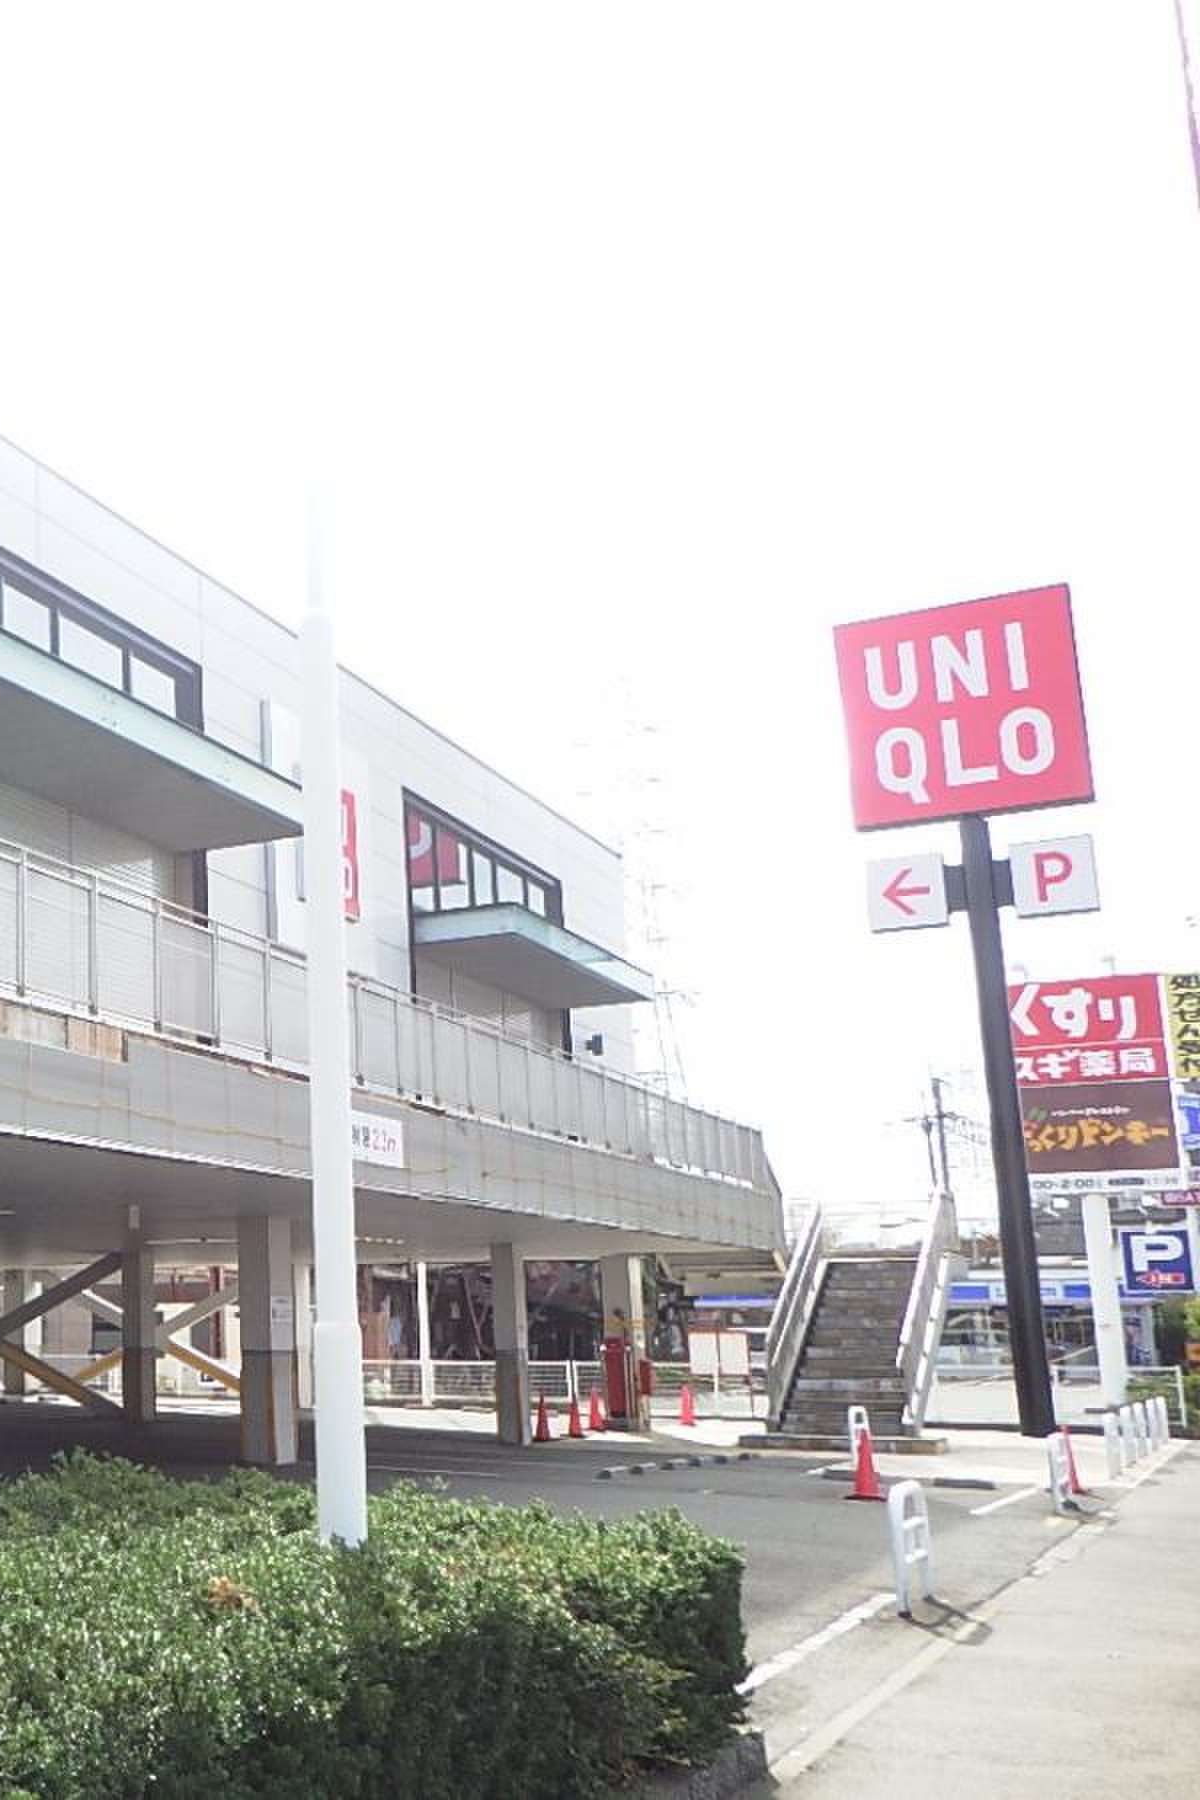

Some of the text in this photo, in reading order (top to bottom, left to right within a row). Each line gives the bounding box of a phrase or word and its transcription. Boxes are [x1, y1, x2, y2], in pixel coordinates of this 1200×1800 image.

[863, 621, 1031, 711] UNI
[874, 706, 1056, 806] QLO
[1032, 851, 1073, 902] P
[1009, 985, 1137, 1038] くすり
[1016, 1048, 1155, 1080] スギ薬局
[1130, 1235, 1184, 1272] P
